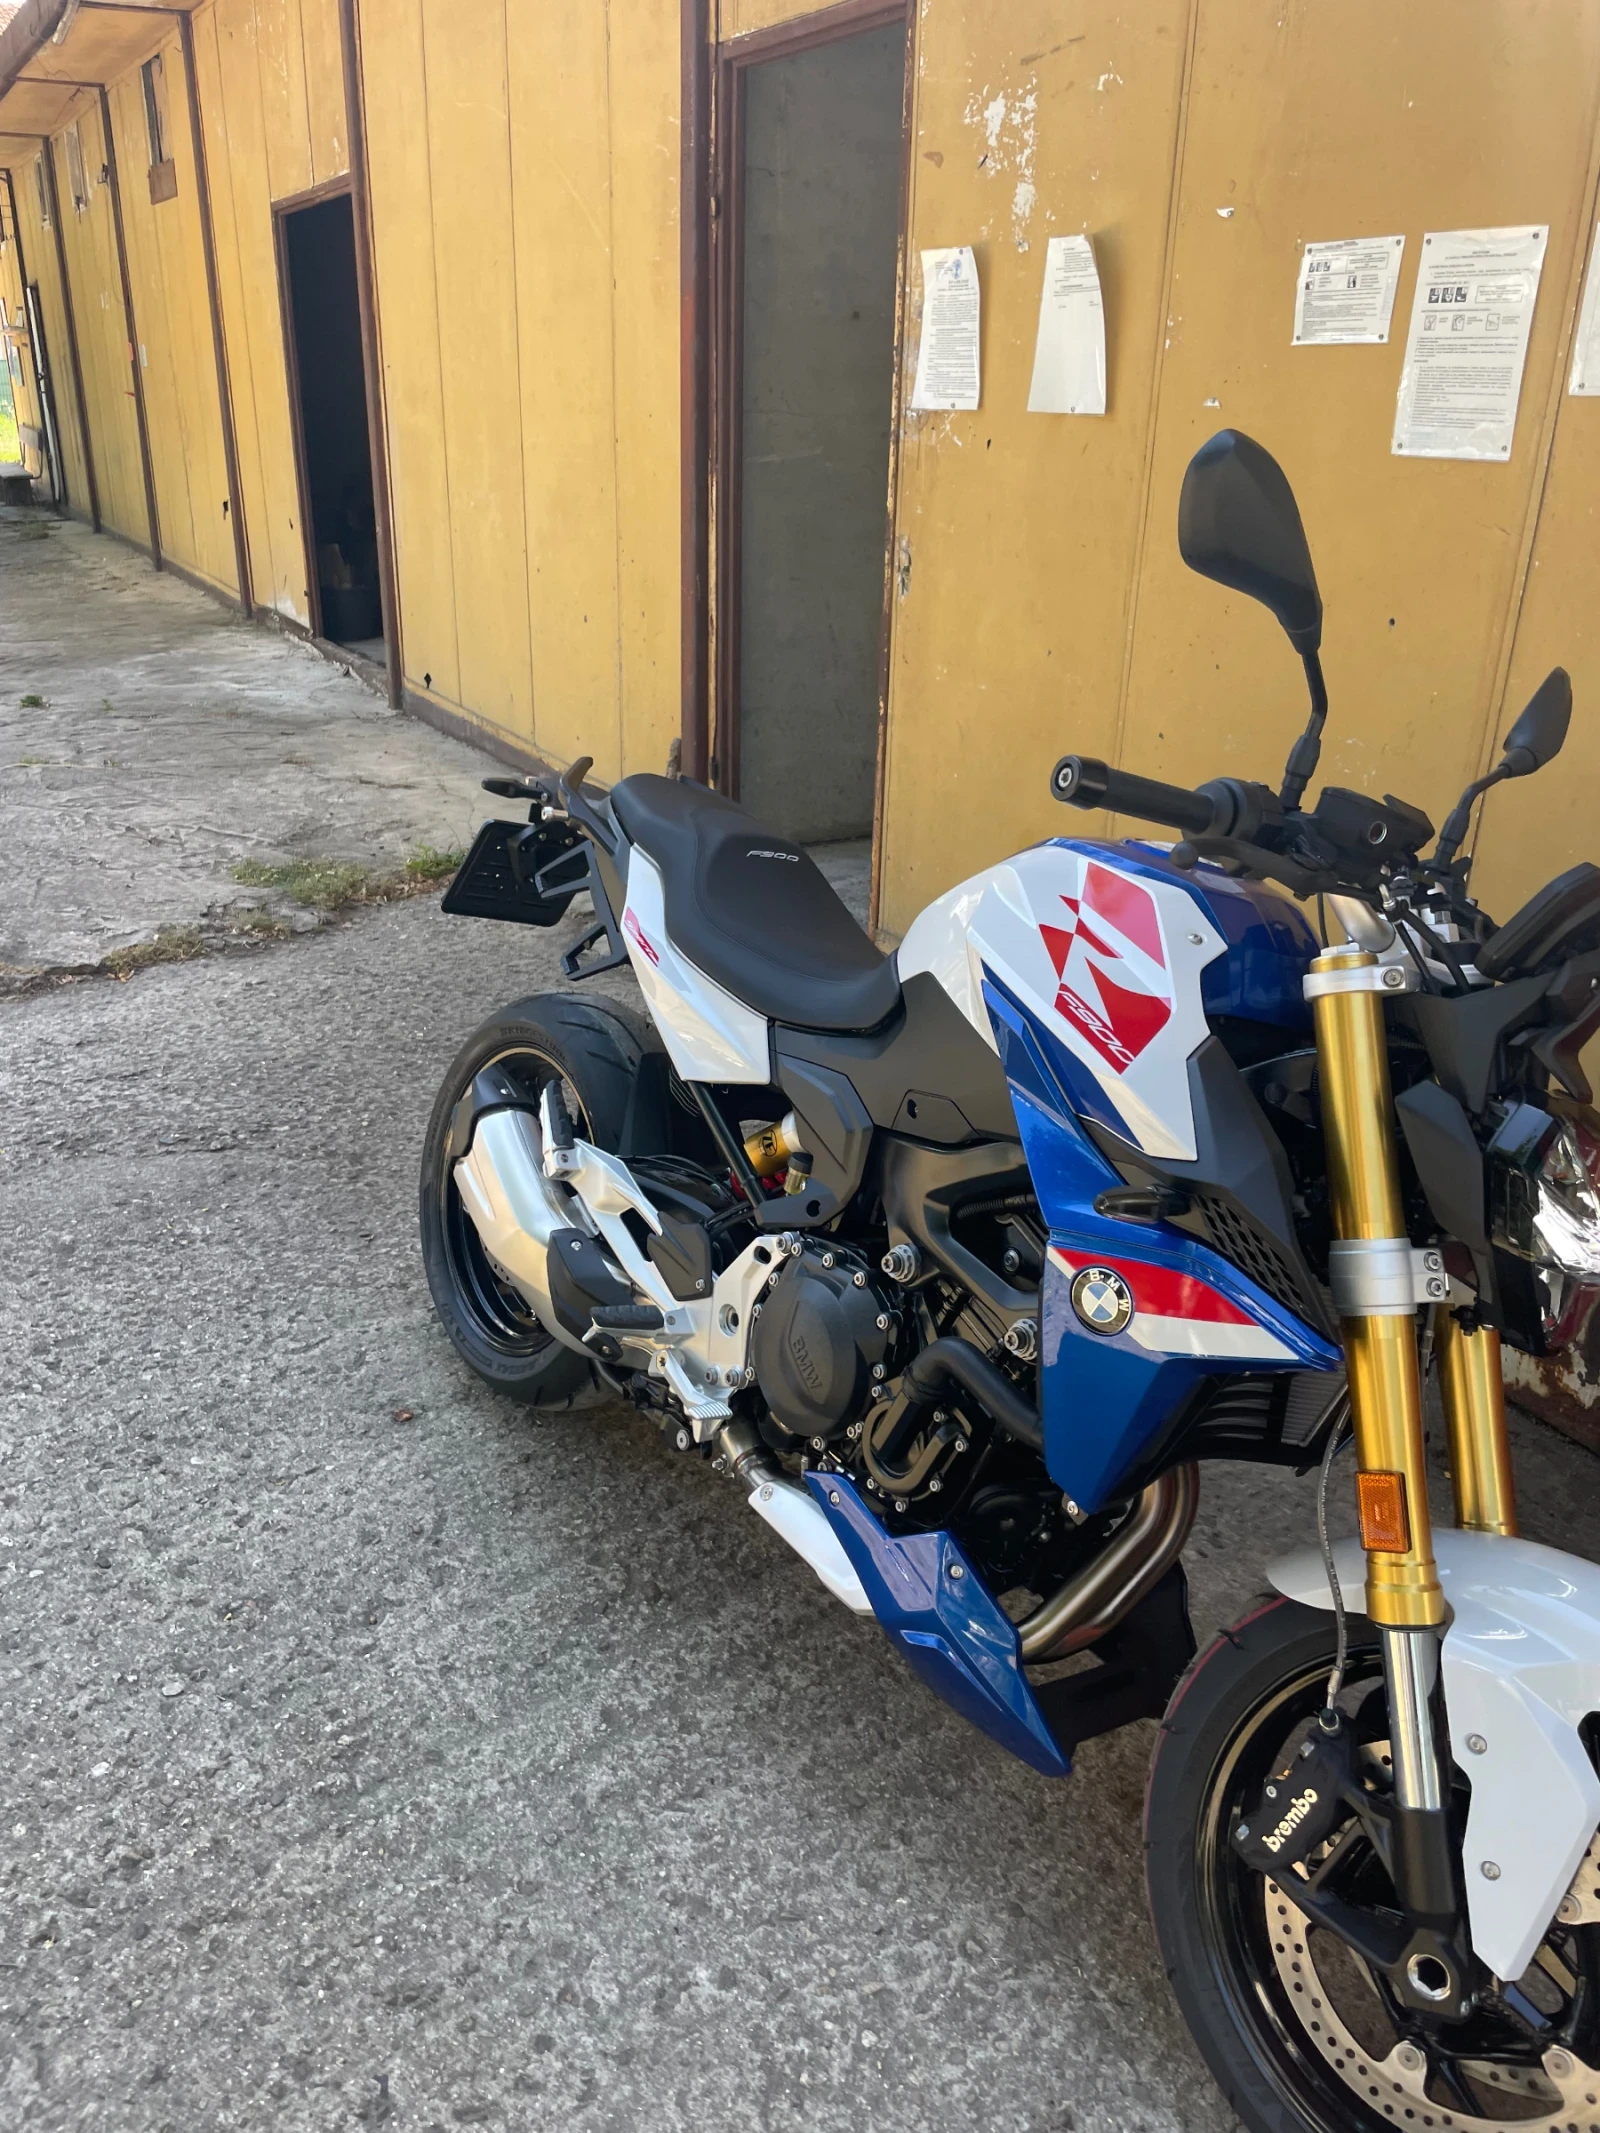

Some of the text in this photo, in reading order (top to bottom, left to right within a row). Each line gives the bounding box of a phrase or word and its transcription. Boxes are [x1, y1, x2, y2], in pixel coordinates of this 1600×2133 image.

[746, 850, 799, 862] F900
[1057, 990, 1136, 1065] F900
[1089, 1269, 1130, 1312] BMW
[792, 1335, 823, 1389] BMW
[1261, 1788, 1318, 1853] brembo
